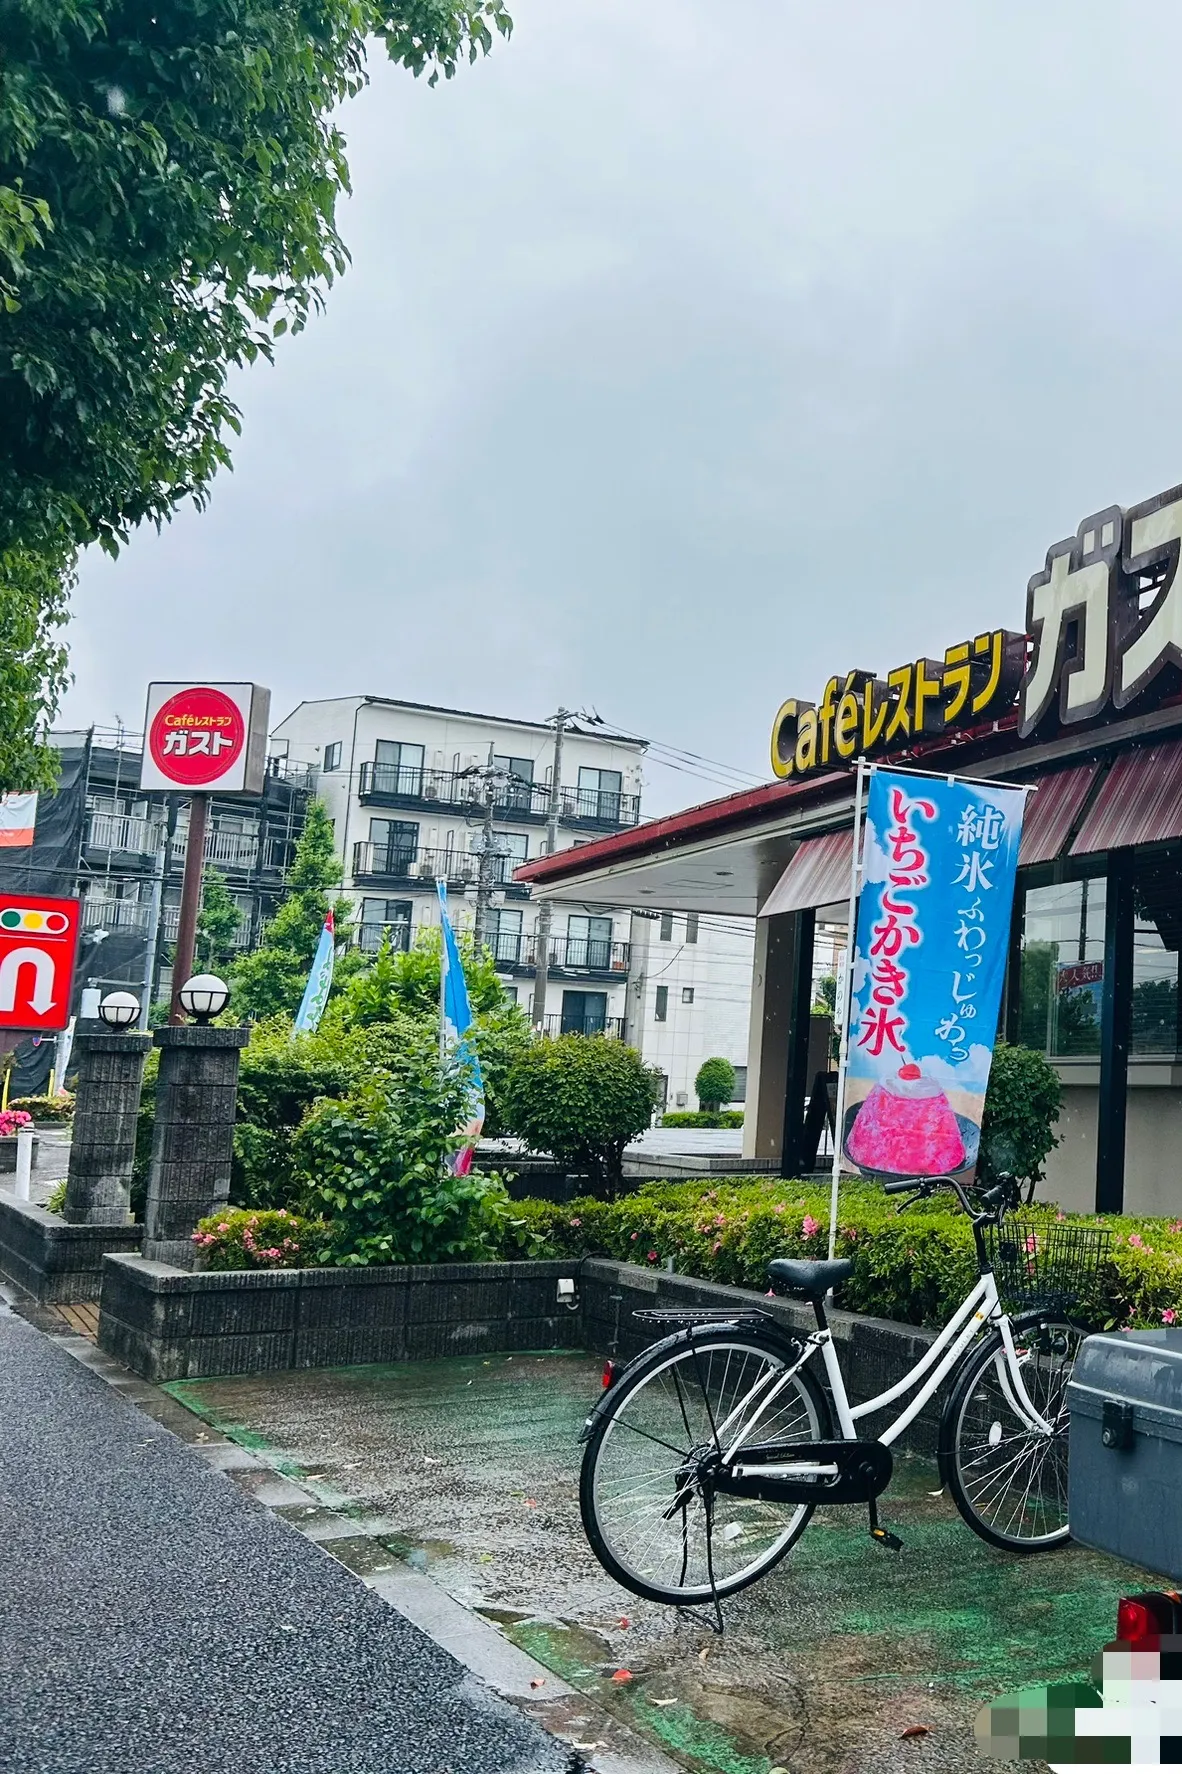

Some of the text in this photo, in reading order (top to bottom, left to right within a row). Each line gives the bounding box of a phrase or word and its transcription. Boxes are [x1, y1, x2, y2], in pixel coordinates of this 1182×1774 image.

[163, 729, 234, 756] ガスト
[857, 790, 935, 1056] いちごかき氷
